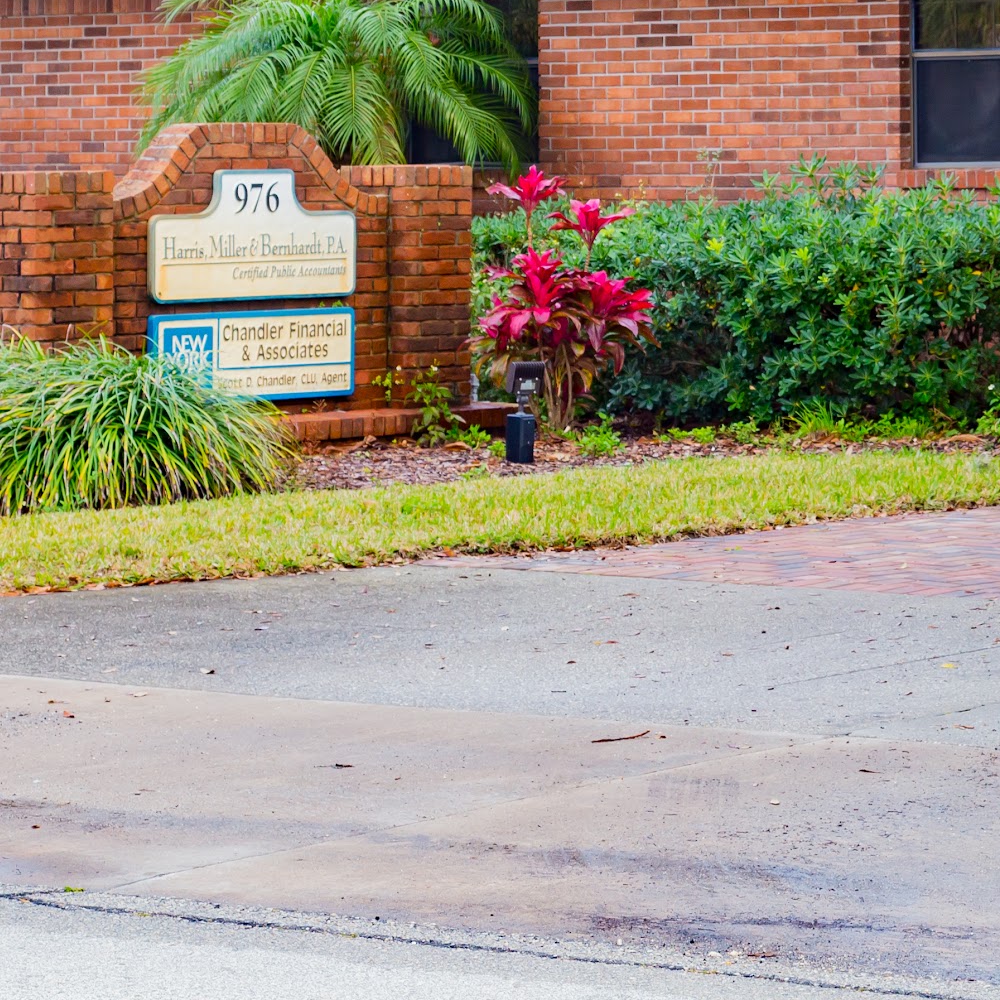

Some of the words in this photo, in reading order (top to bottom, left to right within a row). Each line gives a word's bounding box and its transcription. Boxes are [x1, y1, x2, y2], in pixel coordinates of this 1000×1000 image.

[234, 182, 280, 214] 976
[162, 236, 207, 261] Harris,
[209, 233, 248, 259] Miller
[249, 238, 259, 257] &
[260, 231, 325, 257] Bernhardt,
[325, 235, 348, 255] P.A.
[232, 265, 269, 282] Certified
[270, 264, 296, 278] Public
[298, 264, 347, 277] Accountants
[222, 323, 284, 342] Chandler
[289, 319, 347, 338] Financial
[172, 334, 208, 354] NEW
[241, 345, 251, 361] &
[256, 342, 328, 361] Associates
[166, 350, 213, 370] YORK
[257, 374, 298, 387] Chandler,
[322, 371, 347, 384] Agent
